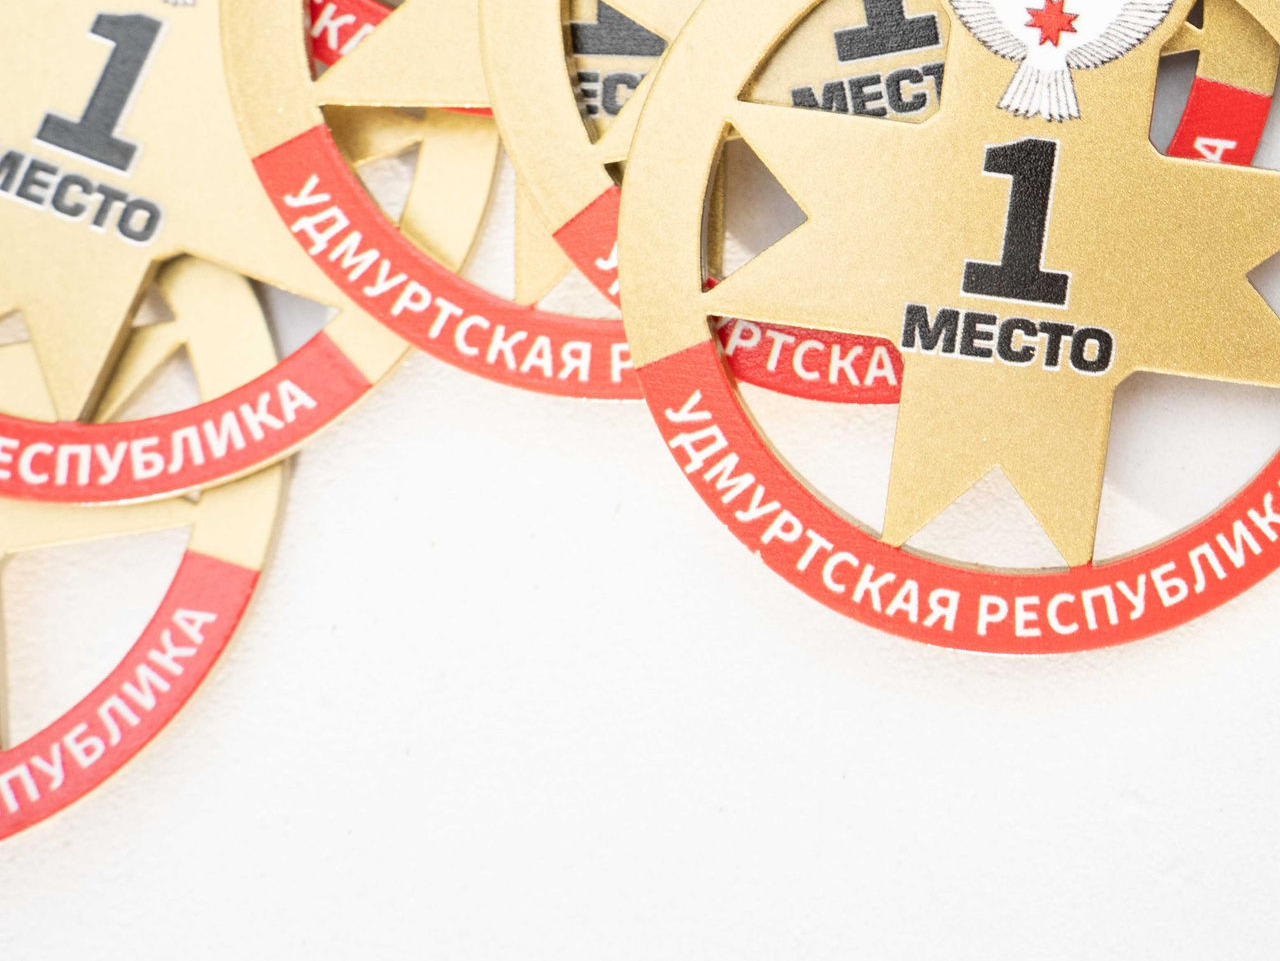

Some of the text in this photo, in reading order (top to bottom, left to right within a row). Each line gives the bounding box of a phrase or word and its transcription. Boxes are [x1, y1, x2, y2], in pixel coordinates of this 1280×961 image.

[36, 13, 163, 172] 1
[284, 173, 592, 383] УДМУРТСКАЯ
[962, 138, 1069, 307] 1
[716, 317, 898, 386] РТСКА
[900, 302, 1114, 374] МЕСТО
[664, 380, 960, 632] УДМУРТСКАЯ
[0, 607, 218, 814] ПУБЛИКА
